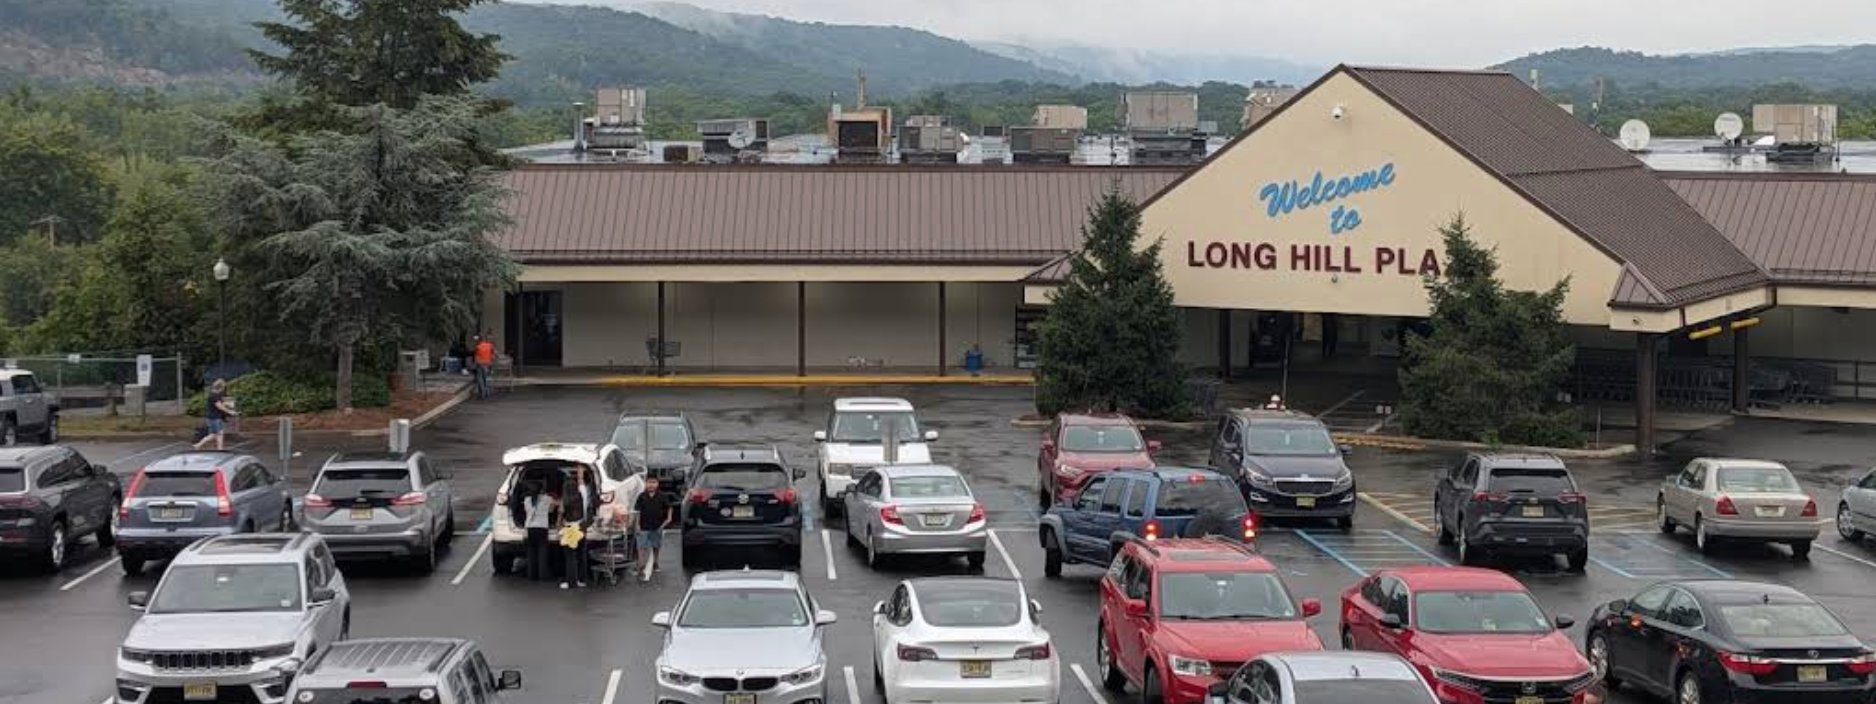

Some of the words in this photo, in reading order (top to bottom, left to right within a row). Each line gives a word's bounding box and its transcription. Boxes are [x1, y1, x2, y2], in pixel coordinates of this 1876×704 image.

[1260, 162, 1396, 217] Welcome
[1331, 205, 1362, 235] to
[1187, 240, 1278, 271] LONG
[1290, 244, 1362, 273] HILL
[1376, 247, 1441, 276] PLA
